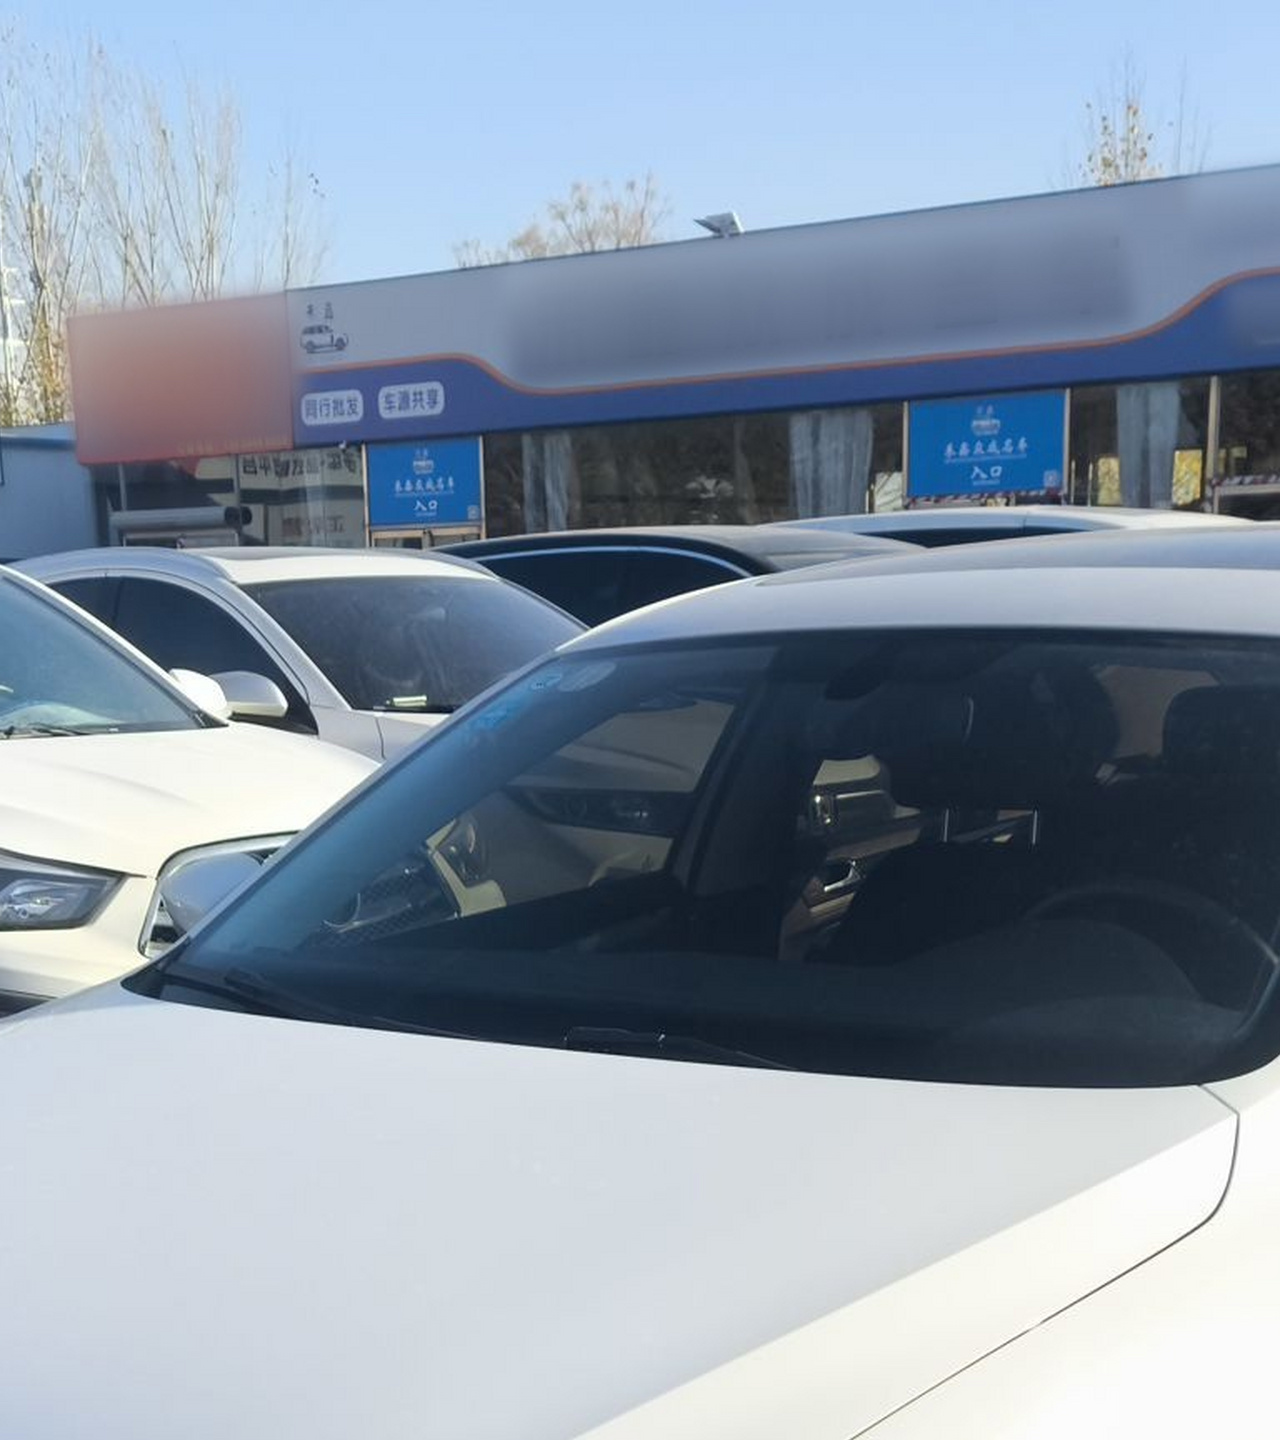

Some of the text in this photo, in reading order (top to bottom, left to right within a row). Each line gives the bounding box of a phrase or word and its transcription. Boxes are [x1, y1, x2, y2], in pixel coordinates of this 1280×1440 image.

[383, 387, 440, 413] 车源共享
[970, 465, 1003, 480] 入口
[413, 500, 439, 512] 入口
